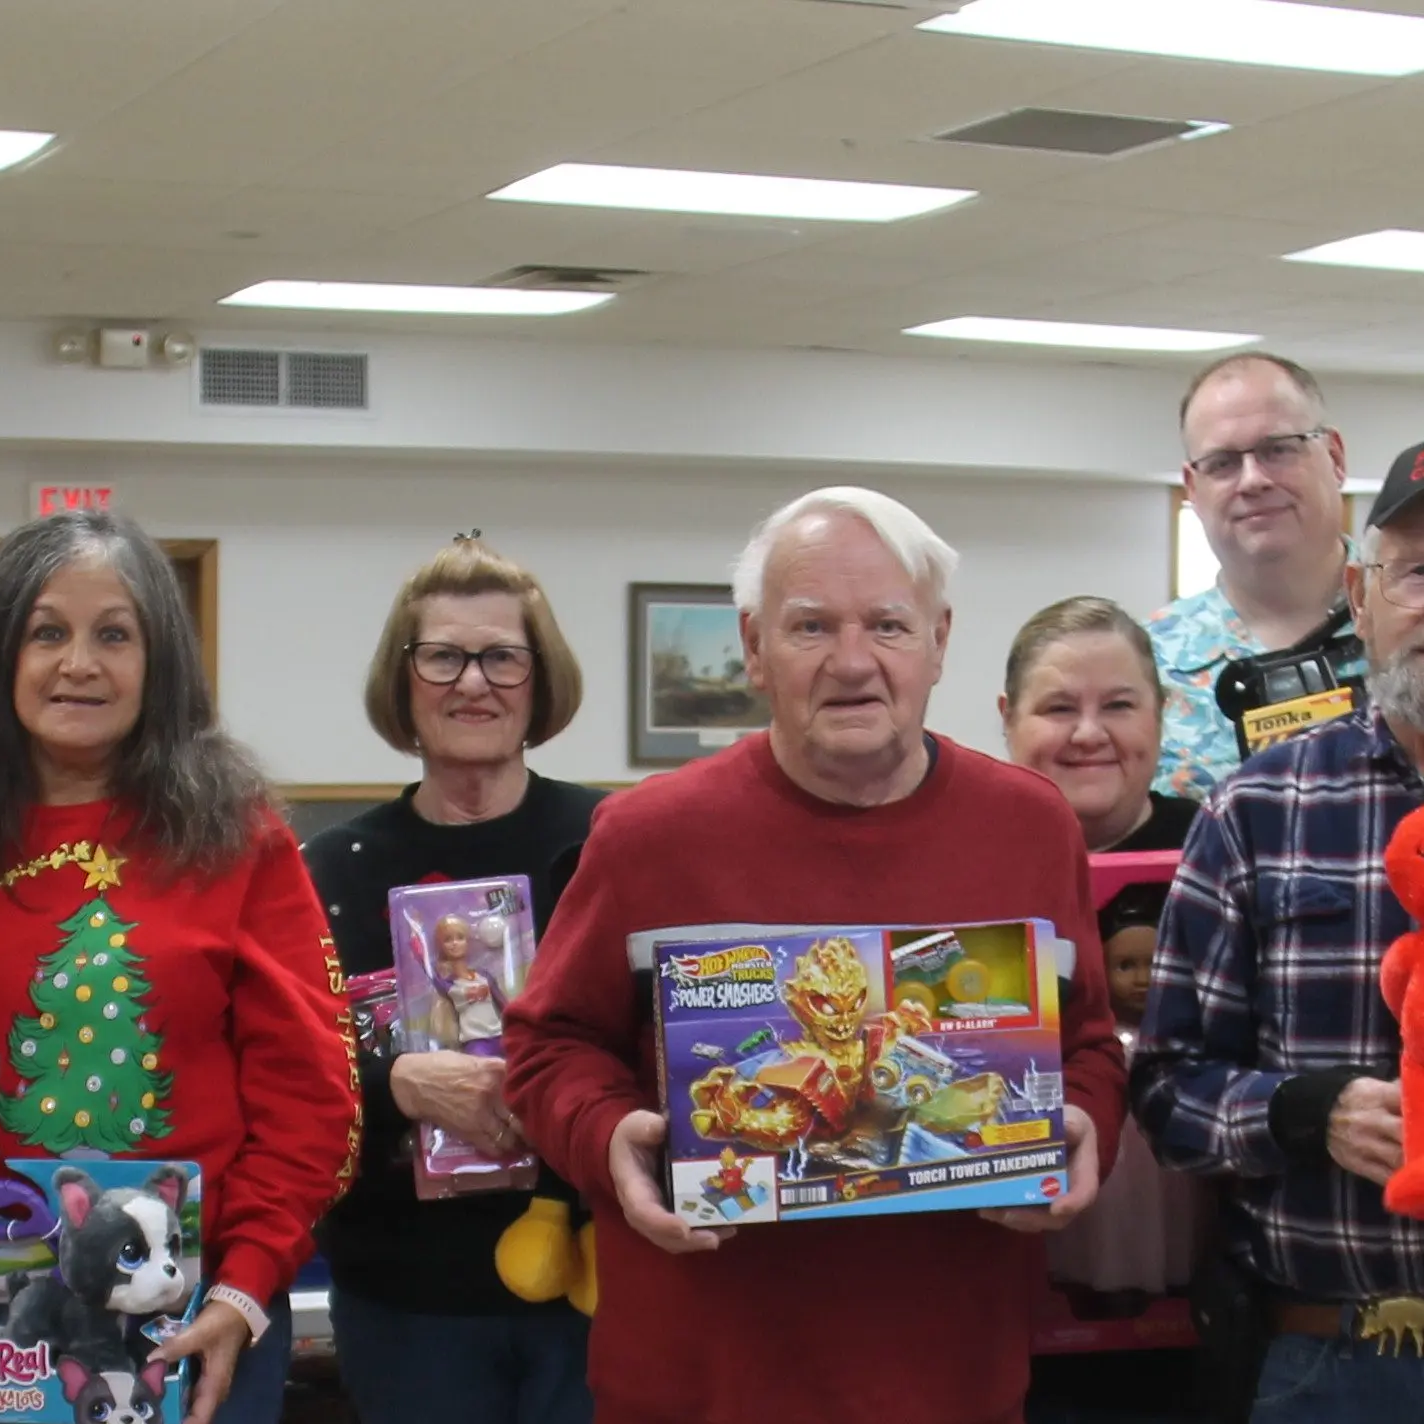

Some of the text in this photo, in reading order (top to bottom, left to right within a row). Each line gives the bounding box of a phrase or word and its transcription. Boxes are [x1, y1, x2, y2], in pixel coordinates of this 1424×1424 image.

[39, 486, 113, 517] EXIT
[1247, 711, 1313, 732] Tonka
[700, 954, 728, 976] HOT
[732, 968, 774, 980] TRUCKS
[678, 982, 776, 1009] POWER SMASHERS
[908, 1168, 947, 1186] TORCH
[949, 1163, 990, 1180] TOWER
